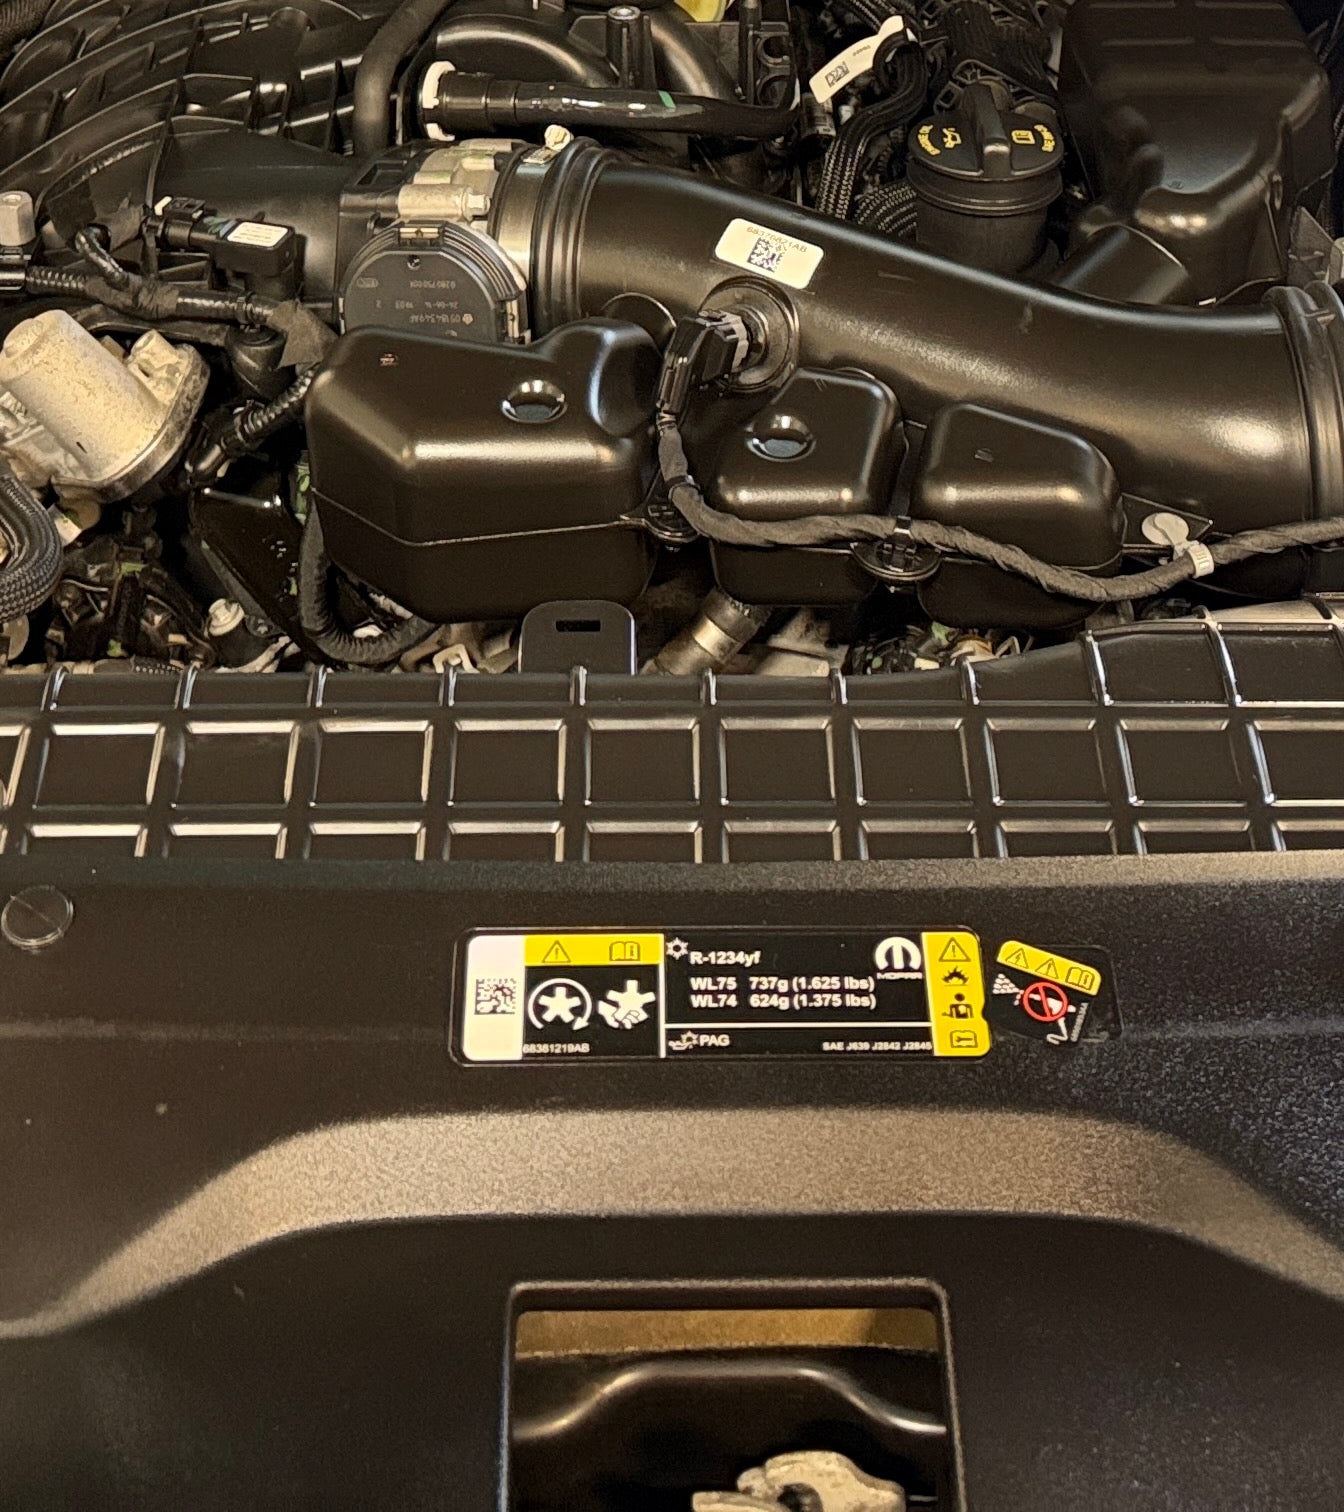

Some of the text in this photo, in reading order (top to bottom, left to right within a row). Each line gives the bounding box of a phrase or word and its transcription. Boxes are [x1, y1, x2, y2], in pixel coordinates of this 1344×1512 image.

[689, 950, 761, 968] R-1234yf
[689, 975, 875, 993] WL75 737g (1.625 lbs)
[690, 993, 876, 1011] WL74 624g (1.375 lbs)
[699, 1034, 731, 1047] PAG
[822, 1041, 844, 1051] SAE
